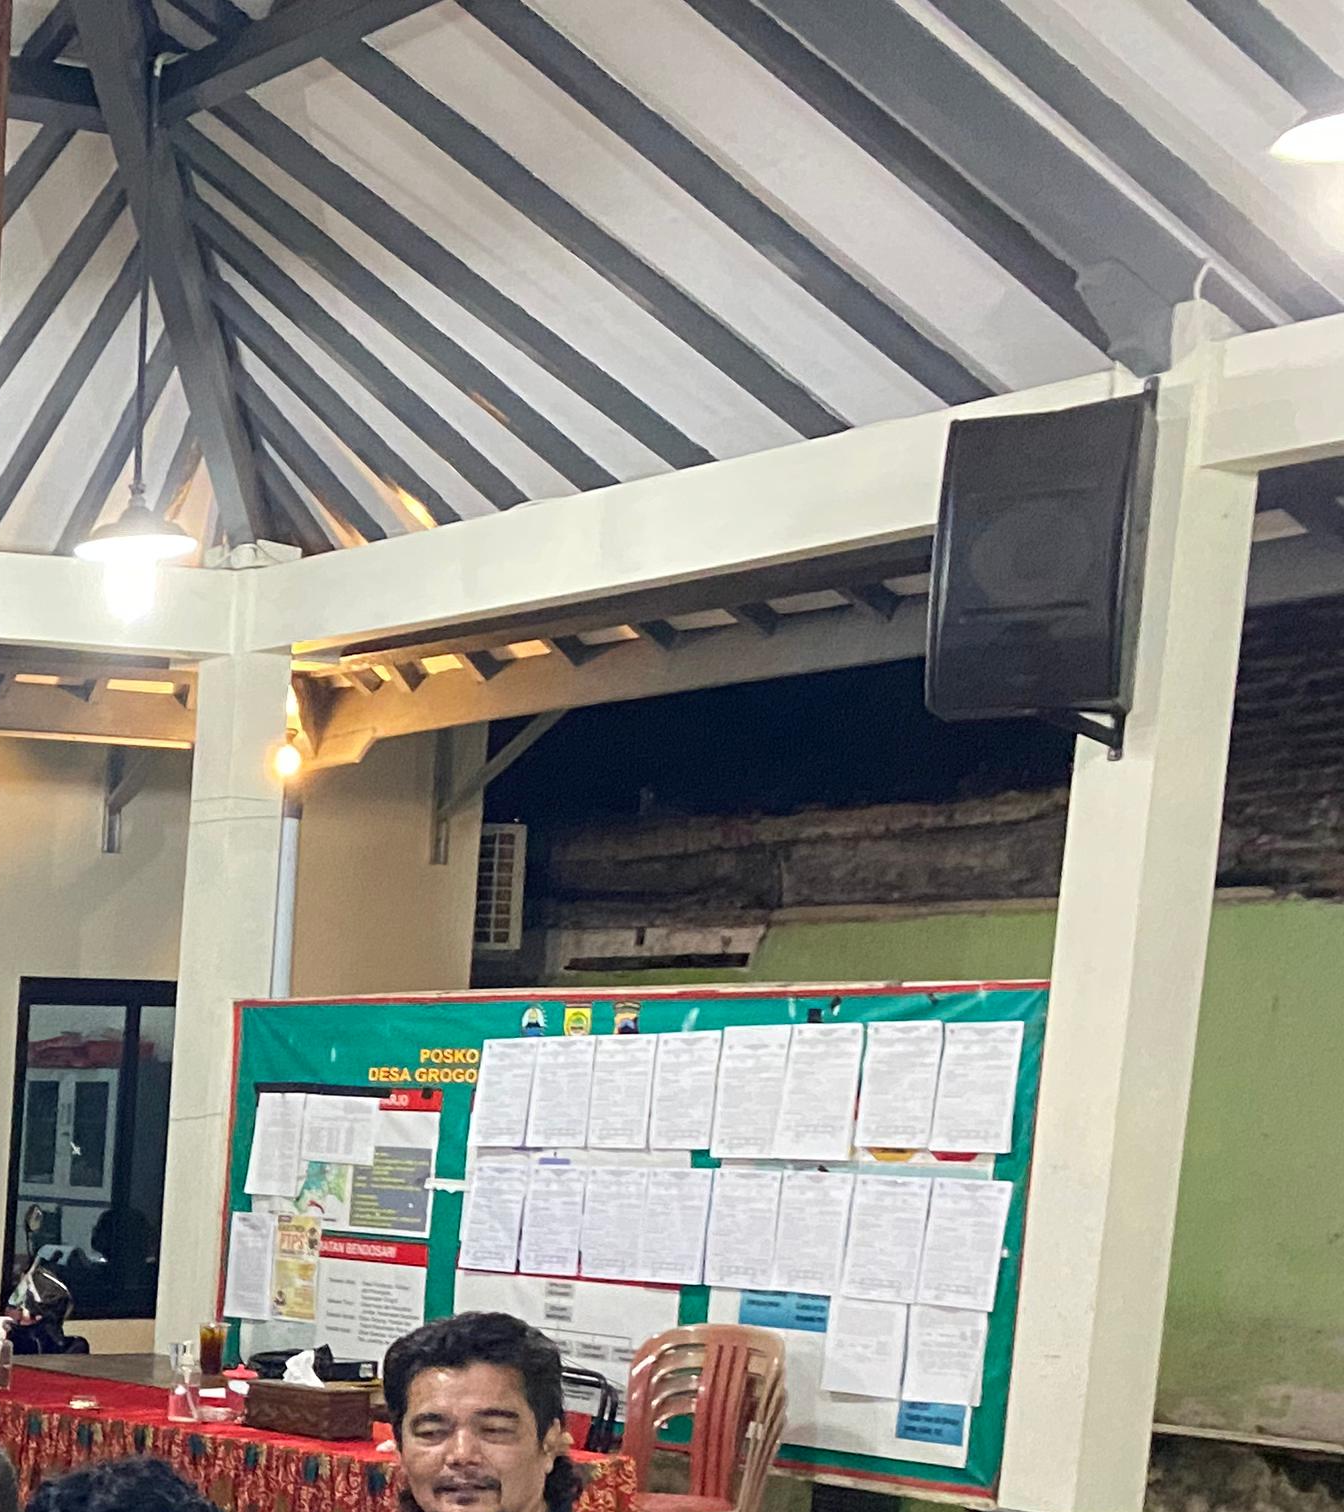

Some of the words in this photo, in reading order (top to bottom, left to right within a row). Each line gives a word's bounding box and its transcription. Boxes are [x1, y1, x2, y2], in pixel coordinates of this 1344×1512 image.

[419, 1048, 480, 1064] POSKO
[368, 1067, 412, 1082] DESA
[414, 1068, 478, 1084] GROGO
